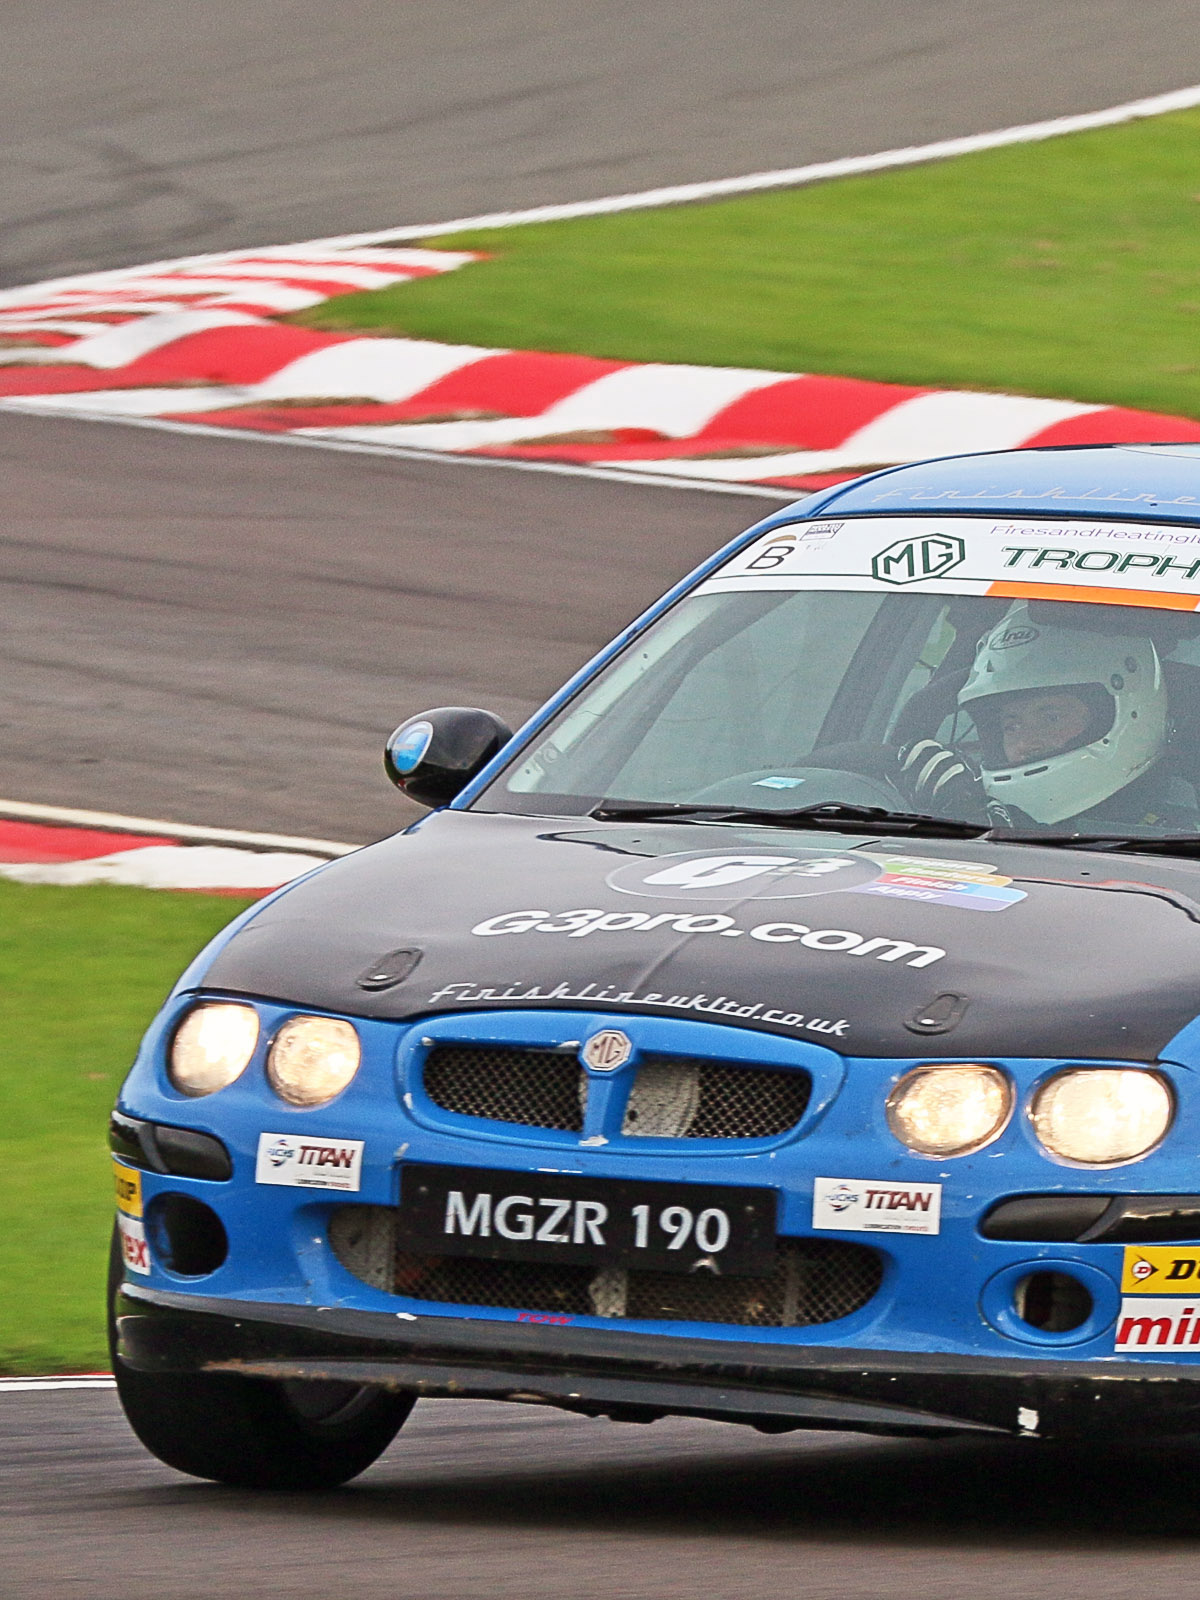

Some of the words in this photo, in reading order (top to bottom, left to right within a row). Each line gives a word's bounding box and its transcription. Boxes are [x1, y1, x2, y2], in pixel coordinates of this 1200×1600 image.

[745, 546, 795, 569] B
[880, 537, 957, 580] MG
[867, 885, 944, 900] Apply
[891, 876, 969, 891] Finish
[471, 907, 946, 968] G3pro.com
[587, 1033, 628, 1067] MG
[298, 1145, 356, 1168] TITAN
[864, 1189, 933, 1211] TITAN
[444, 1191, 606, 1246] MGZR
[631, 1203, 730, 1253] 190
[516, 1312, 575, 1325] TOW
